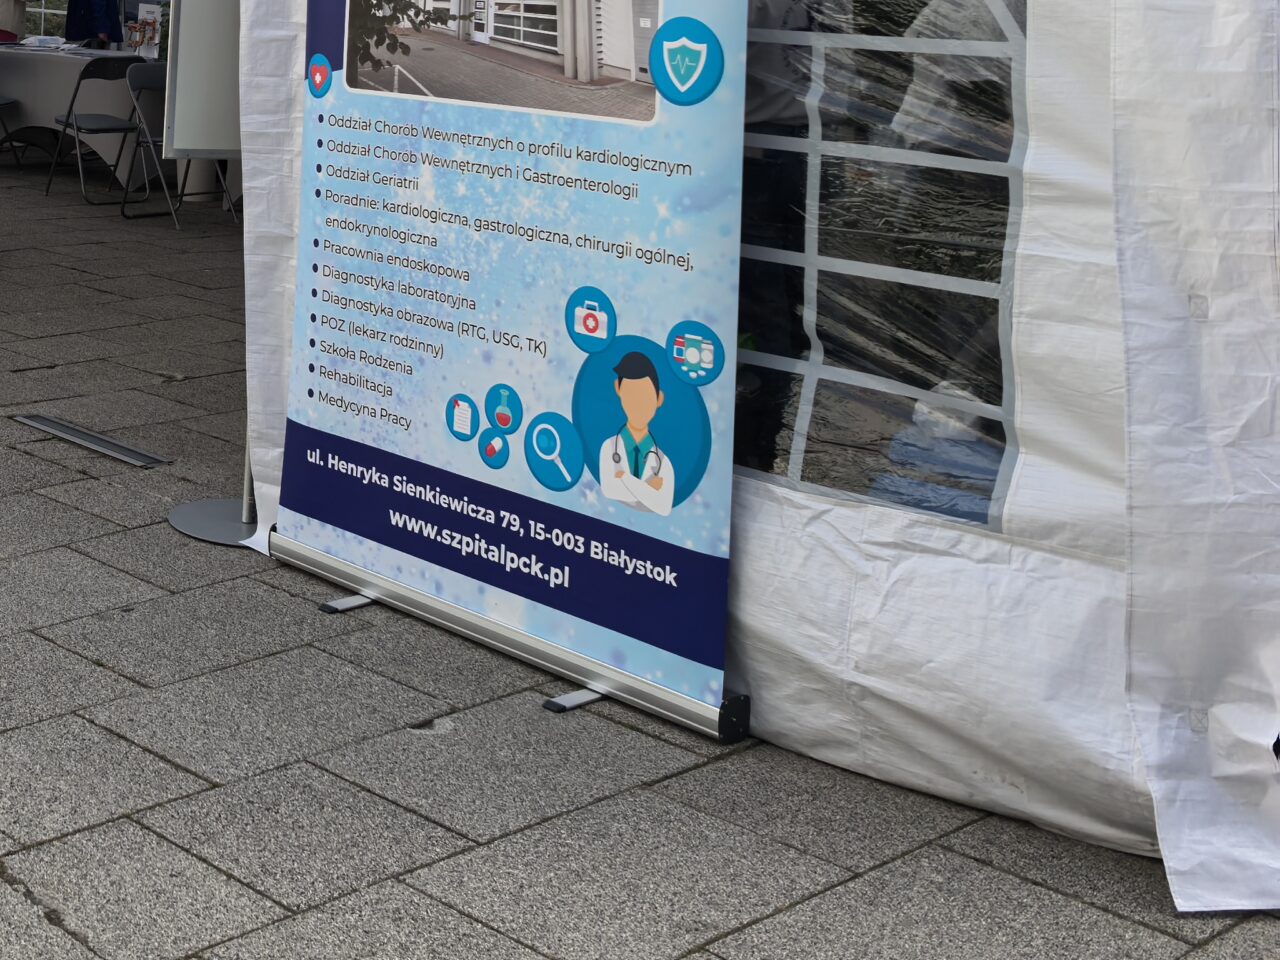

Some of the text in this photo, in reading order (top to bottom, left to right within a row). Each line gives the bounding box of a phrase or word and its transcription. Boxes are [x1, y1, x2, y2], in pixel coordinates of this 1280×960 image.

[328, 114, 692, 176] Oddział Chorób Wewnętrznych o profilu kardiologicznym
[326, 139, 639, 200] Oddział Chorób Wewnętrznych i Gastroenterologii
[326, 164, 419, 191] Oddział Geriatrii
[325, 189, 694, 272] Poradnie: kardiologiczna, gastrologiczna, chirurgii ogólnej,
[325, 216, 438, 248] endokrynologiczna
[323, 239, 470, 282] Pracownia endoskopowa
[322, 264, 476, 310] Diagnostyka laboratoryjna
[320, 315, 444, 359] POZ (lekarz rodzinny)
[321, 289, 547, 358] Diagnostyka obrazowa (RTG, USG, TK)
[320, 340, 413, 376] Szkoła Rodzenia
[319, 365, 393, 397] Rehabilitacja
[318, 390, 412, 431] Medycyna Pracy
[307, 448, 678, 588] ul. Henryka Sienkiewicza 79, 15-003 Białystok
[388, 509, 570, 588] www.szpitalpck.pl
